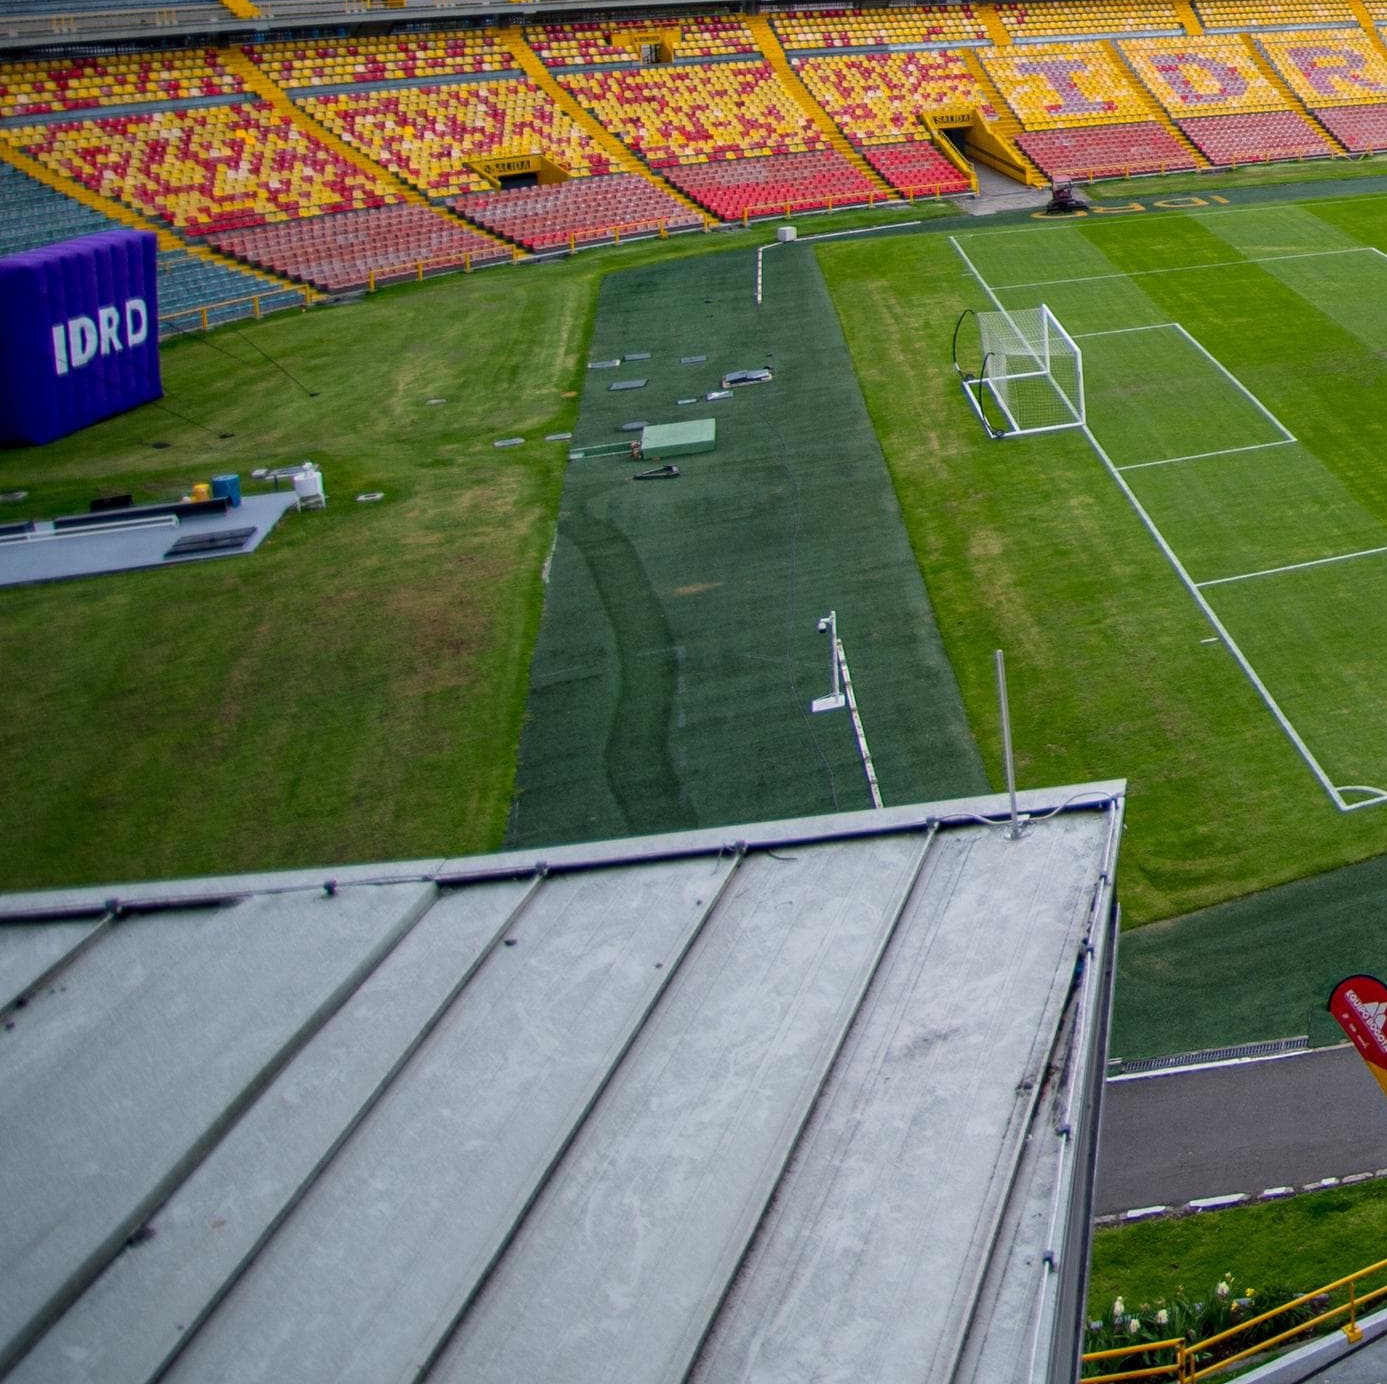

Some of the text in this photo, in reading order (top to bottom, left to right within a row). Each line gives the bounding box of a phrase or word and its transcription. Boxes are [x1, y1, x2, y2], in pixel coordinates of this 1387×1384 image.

[933, 113, 971, 124] SALIDA
[495, 159, 531, 174] SALIDA
[52, 298, 148, 376] IDRD
[1345, 989, 1370, 1020] EQUIPO
